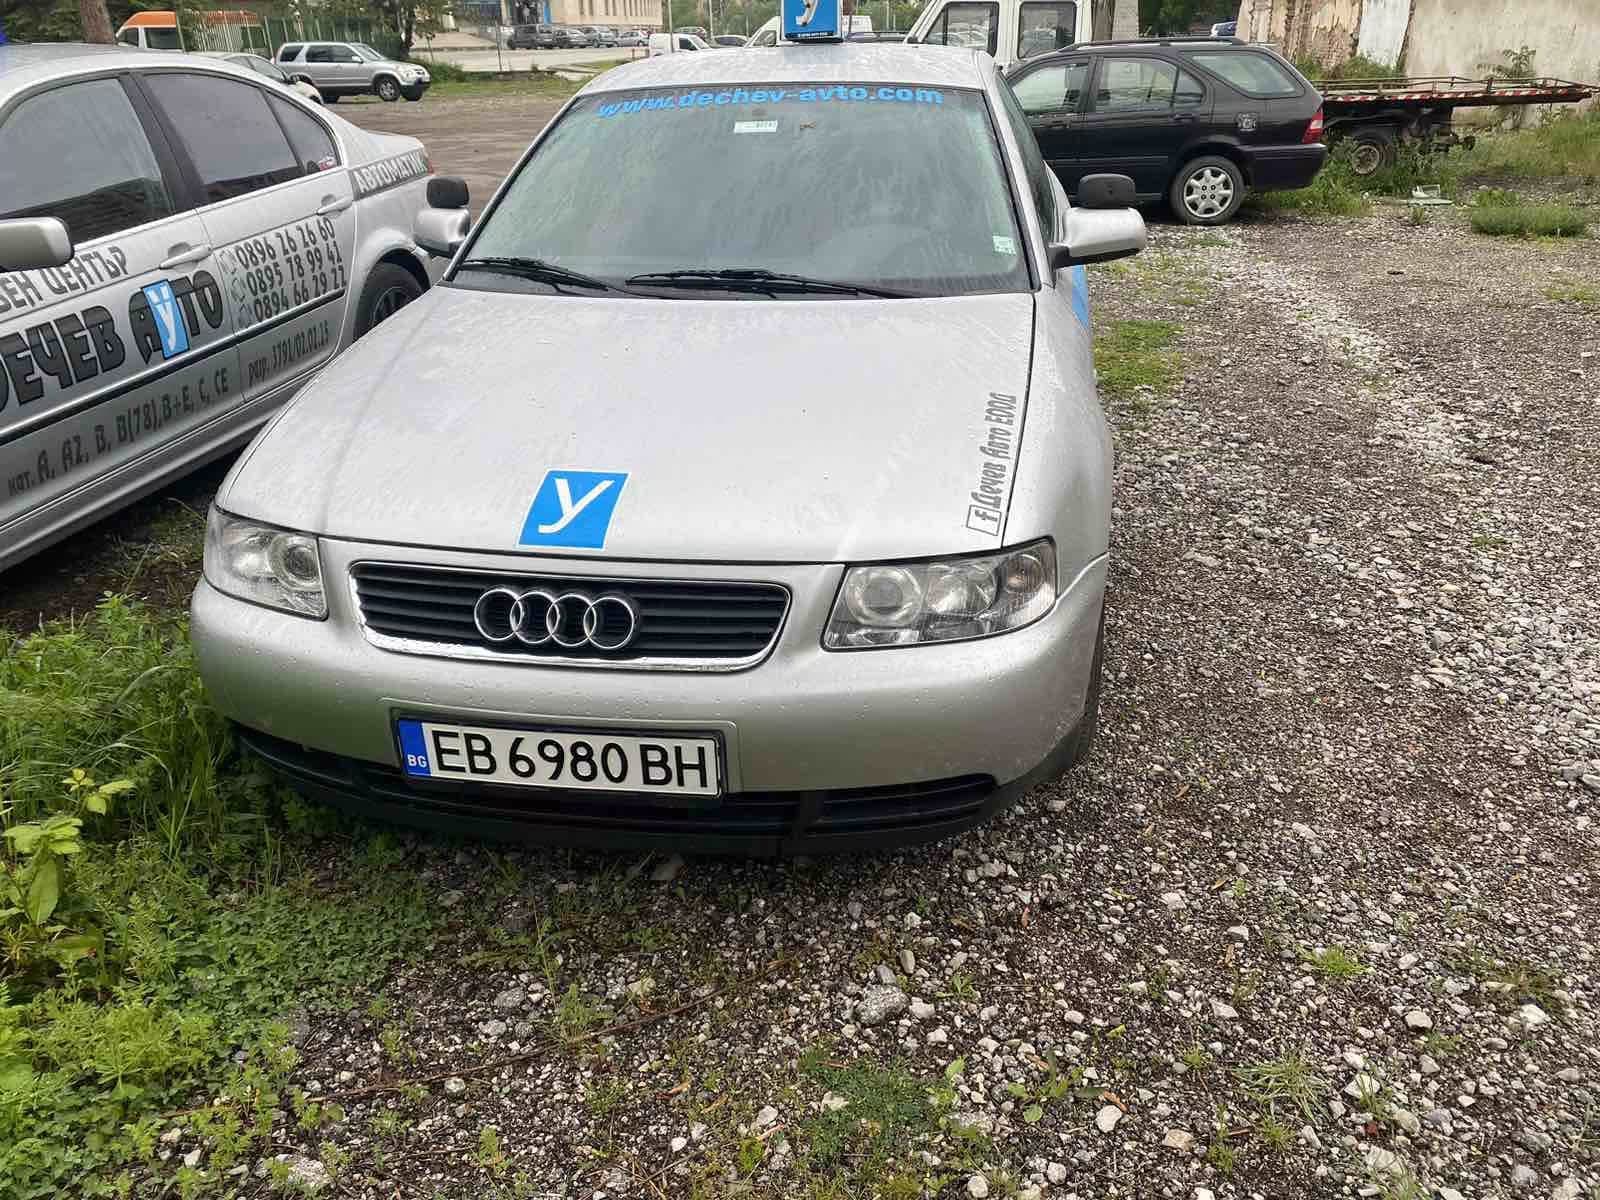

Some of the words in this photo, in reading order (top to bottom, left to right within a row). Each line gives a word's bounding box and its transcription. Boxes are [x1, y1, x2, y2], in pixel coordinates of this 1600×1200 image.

[595, 85, 944, 118] www.dechev-avto.com
[235, 237, 276, 269] 0896
[275, 229, 297, 256] 26
[296, 223, 317, 248] 26
[317, 216, 335, 241] 60
[246, 262, 283, 296] 0895
[285, 254, 304, 281] 78
[306, 247, 323, 273] 99
[254, 288, 288, 321] 0894
[0, 305, 126, 412] ЕЧЕВ
[979, 427, 1012, 460] Авто
[407, 753, 427, 768] BG
[431, 729, 498, 776] EB
[508, 737, 629, 784] 6980
[639, 743, 709, 789] BH
